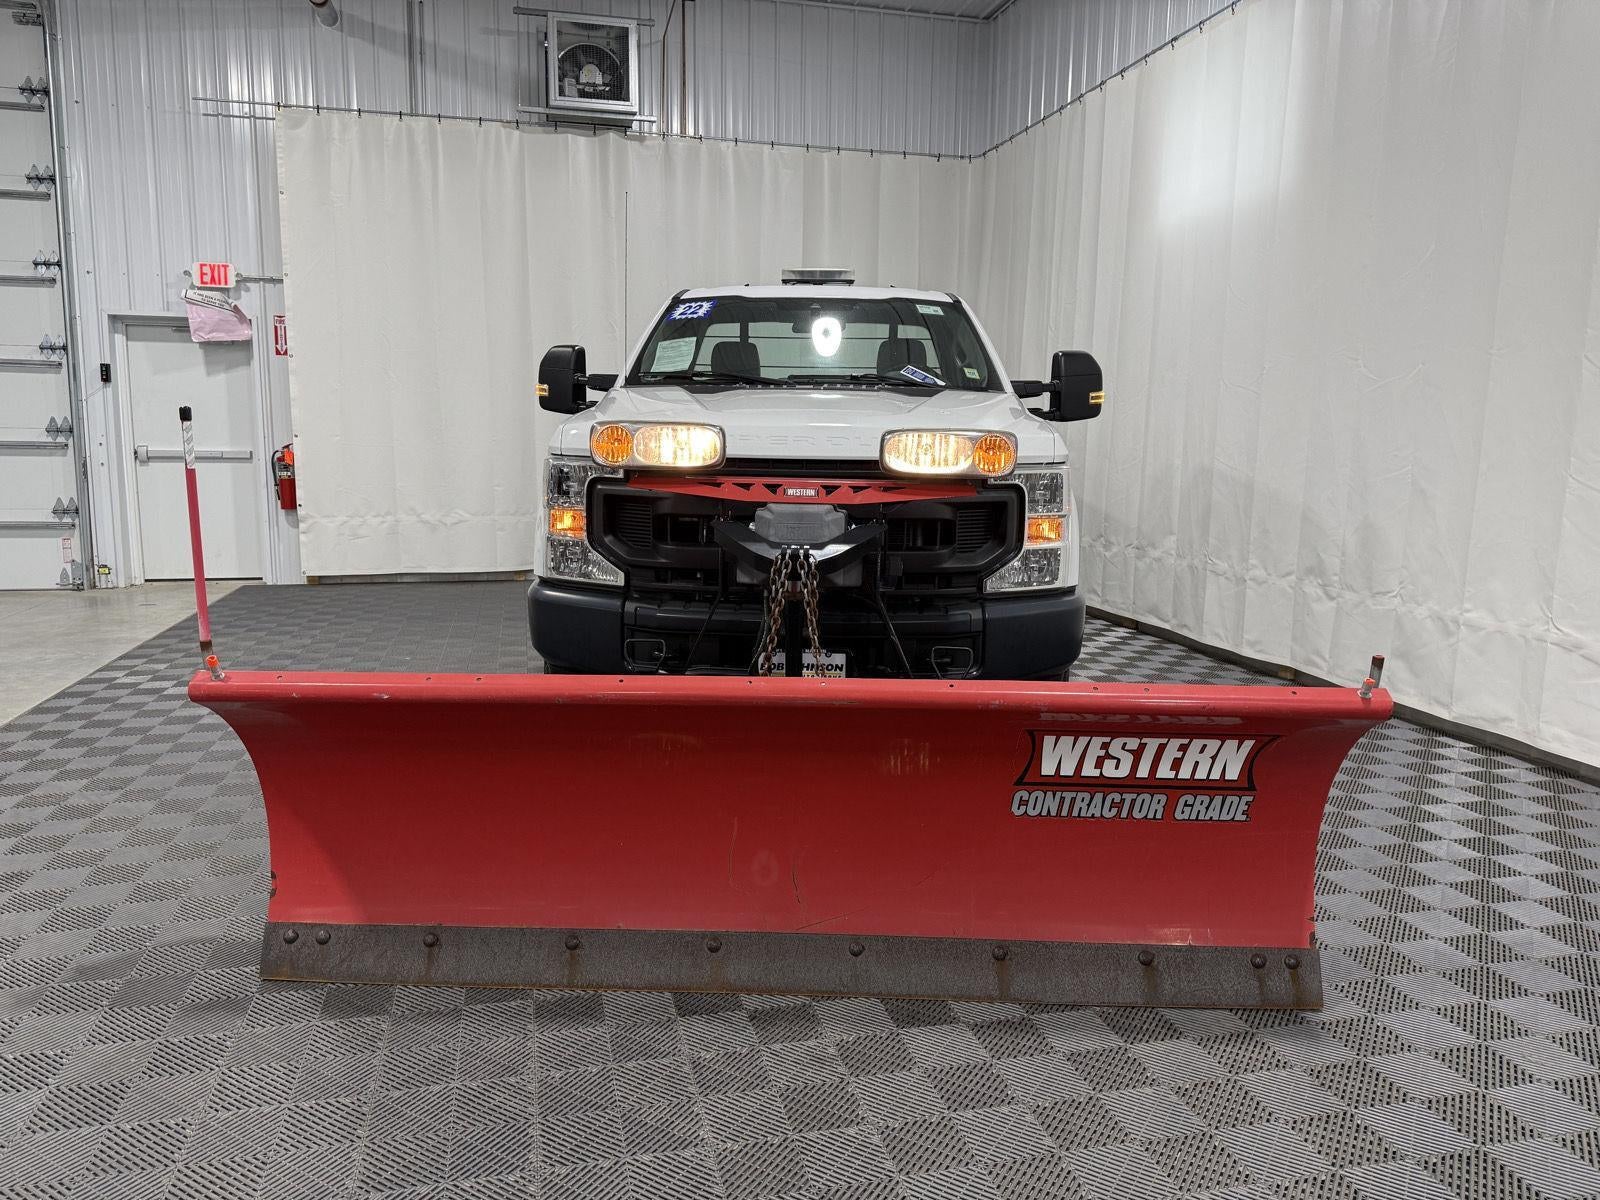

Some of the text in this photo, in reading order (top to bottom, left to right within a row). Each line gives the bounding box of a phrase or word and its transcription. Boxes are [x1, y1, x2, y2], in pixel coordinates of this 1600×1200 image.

[199, 263, 229, 286] EXIT
[678, 304, 703, 316] 22
[787, 488, 816, 497] WESTERN
[1040, 735, 1256, 782] WESTERN
[1011, 789, 1254, 822] CONTRACTOR GRADE
